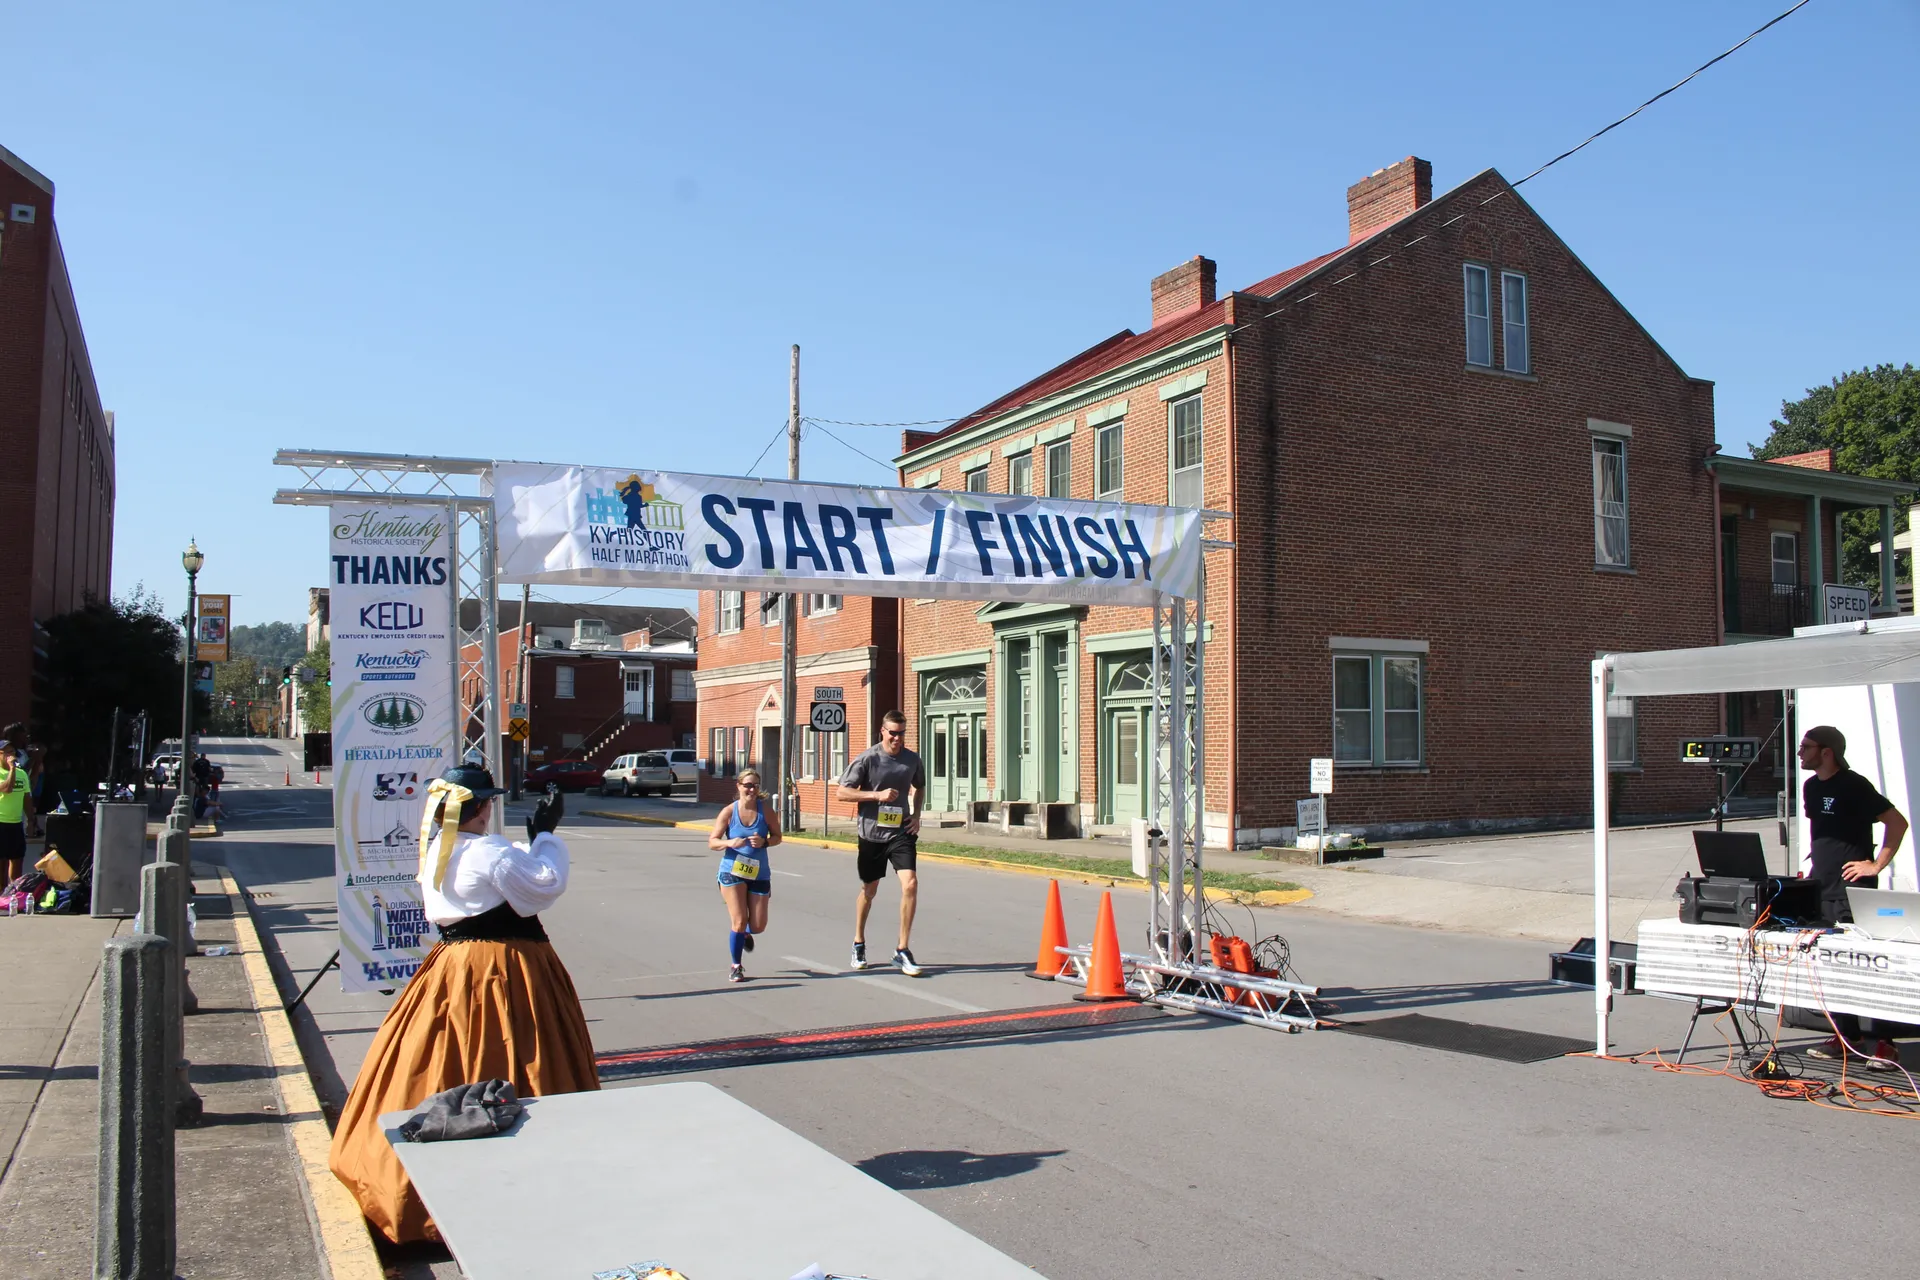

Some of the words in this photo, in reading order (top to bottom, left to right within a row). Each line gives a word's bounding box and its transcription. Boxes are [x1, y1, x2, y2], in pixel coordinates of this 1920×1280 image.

[333, 509, 446, 554] Kentucky
[589, 525, 610, 544] KY
[617, 527, 684, 551] HISTORY
[701, 494, 895, 575] START
[965, 510, 1152, 581] FINISH
[351, 538, 393, 546] HISTORICAL
[395, 538, 426, 546] SOCIETY
[592, 547, 620, 563] HALF
[625, 549, 688, 567] MARATHON
[332, 555, 447, 585] THANKS
[1830, 596, 1866, 612] SPEED
[360, 601, 423, 630] KECU
[1834, 614, 1864, 624] LIM
[355, 652, 421, 669] Kentucky
[816, 690, 842, 698] SOUTH
[814, 709, 843, 725] 420
[345, 747, 443, 760] HERALD-LEADER
[373, 788, 388, 796] abc
[381, 771, 418, 800] 36
[884, 813, 897, 822] 347
[739, 863, 754, 874] 336
[355, 873, 418, 884] Independenc
[386, 909, 427, 923] WATER
[387, 922, 430, 936] TOWER
[388, 935, 421, 949] PARK
[1799, 942, 1889, 971] acing
[362, 962, 385, 981] UK
[387, 963, 422, 980] WU
